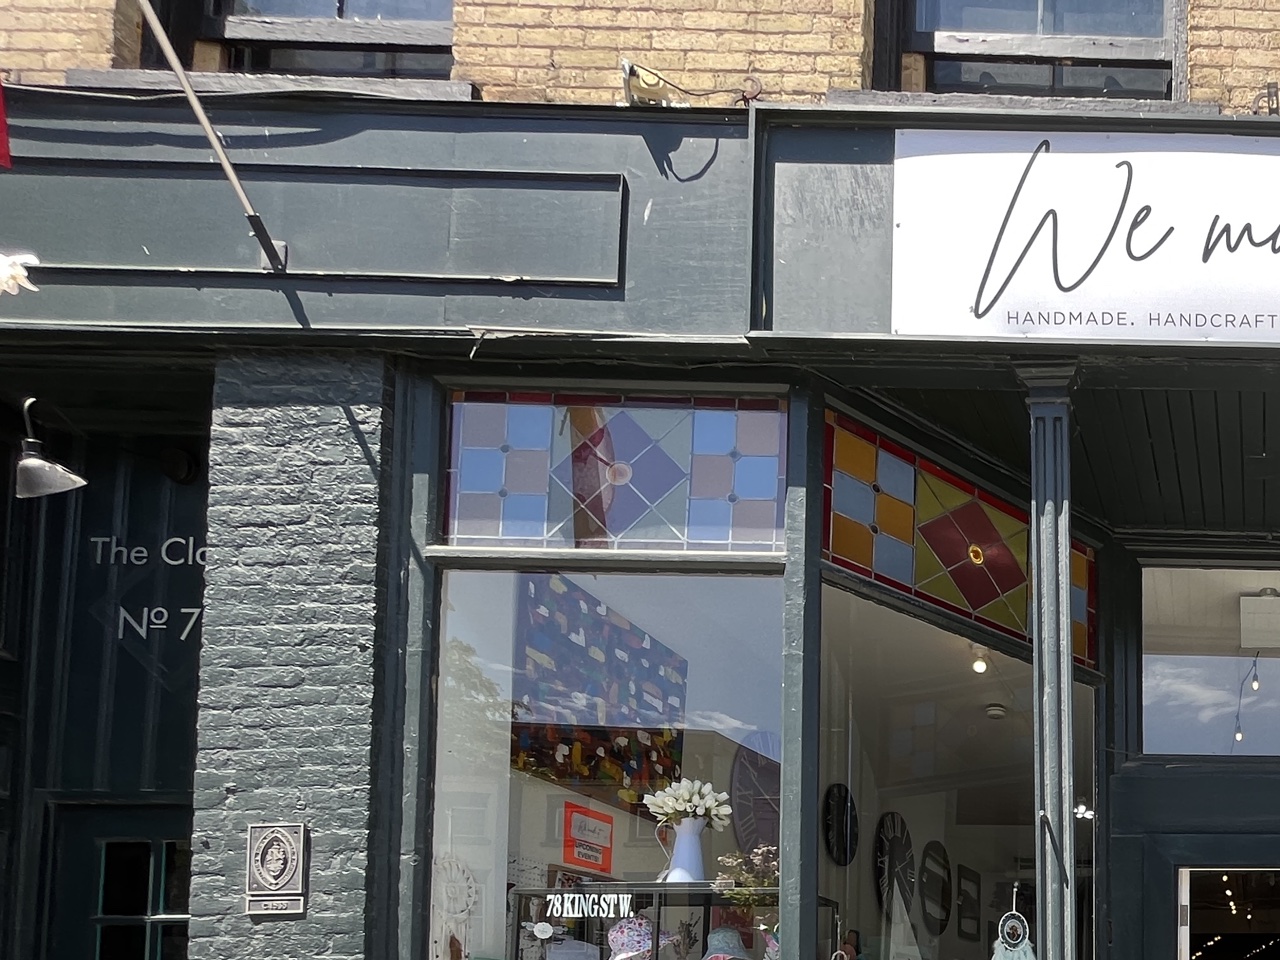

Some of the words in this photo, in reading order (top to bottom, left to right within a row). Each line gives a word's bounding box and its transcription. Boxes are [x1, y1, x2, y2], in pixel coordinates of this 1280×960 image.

[973, 139, 1174, 319] We
[1006, 310, 1135, 327] HANDMADE.
[90, 535, 148, 565] The
[546, 893, 562, 917] 78
[562, 893, 599, 918] KING
[599, 893, 618, 918] ST
[618, 893, 634, 918] W.
